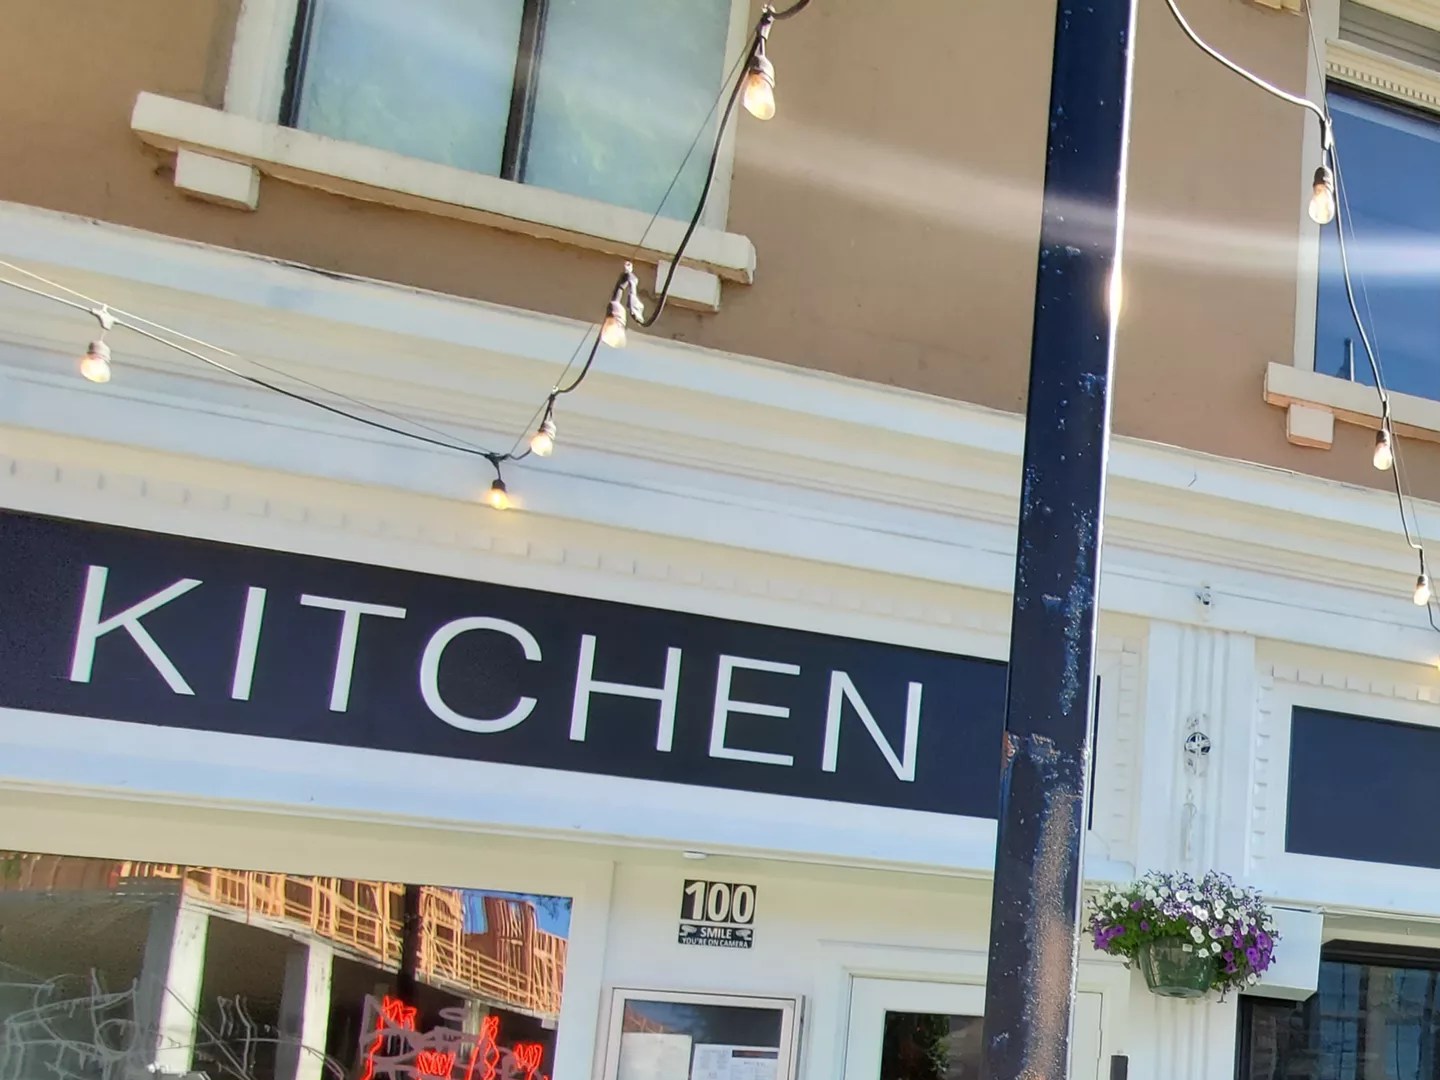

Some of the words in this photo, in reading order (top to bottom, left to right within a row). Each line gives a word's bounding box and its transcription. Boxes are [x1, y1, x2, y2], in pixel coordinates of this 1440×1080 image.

[68, 564, 923, 782] KITCHEN
[685, 881, 755, 923] 100
[700, 927, 733, 939] SMILE
[708, 939, 719, 947] ON
[720, 940, 749, 949] CAMERA
